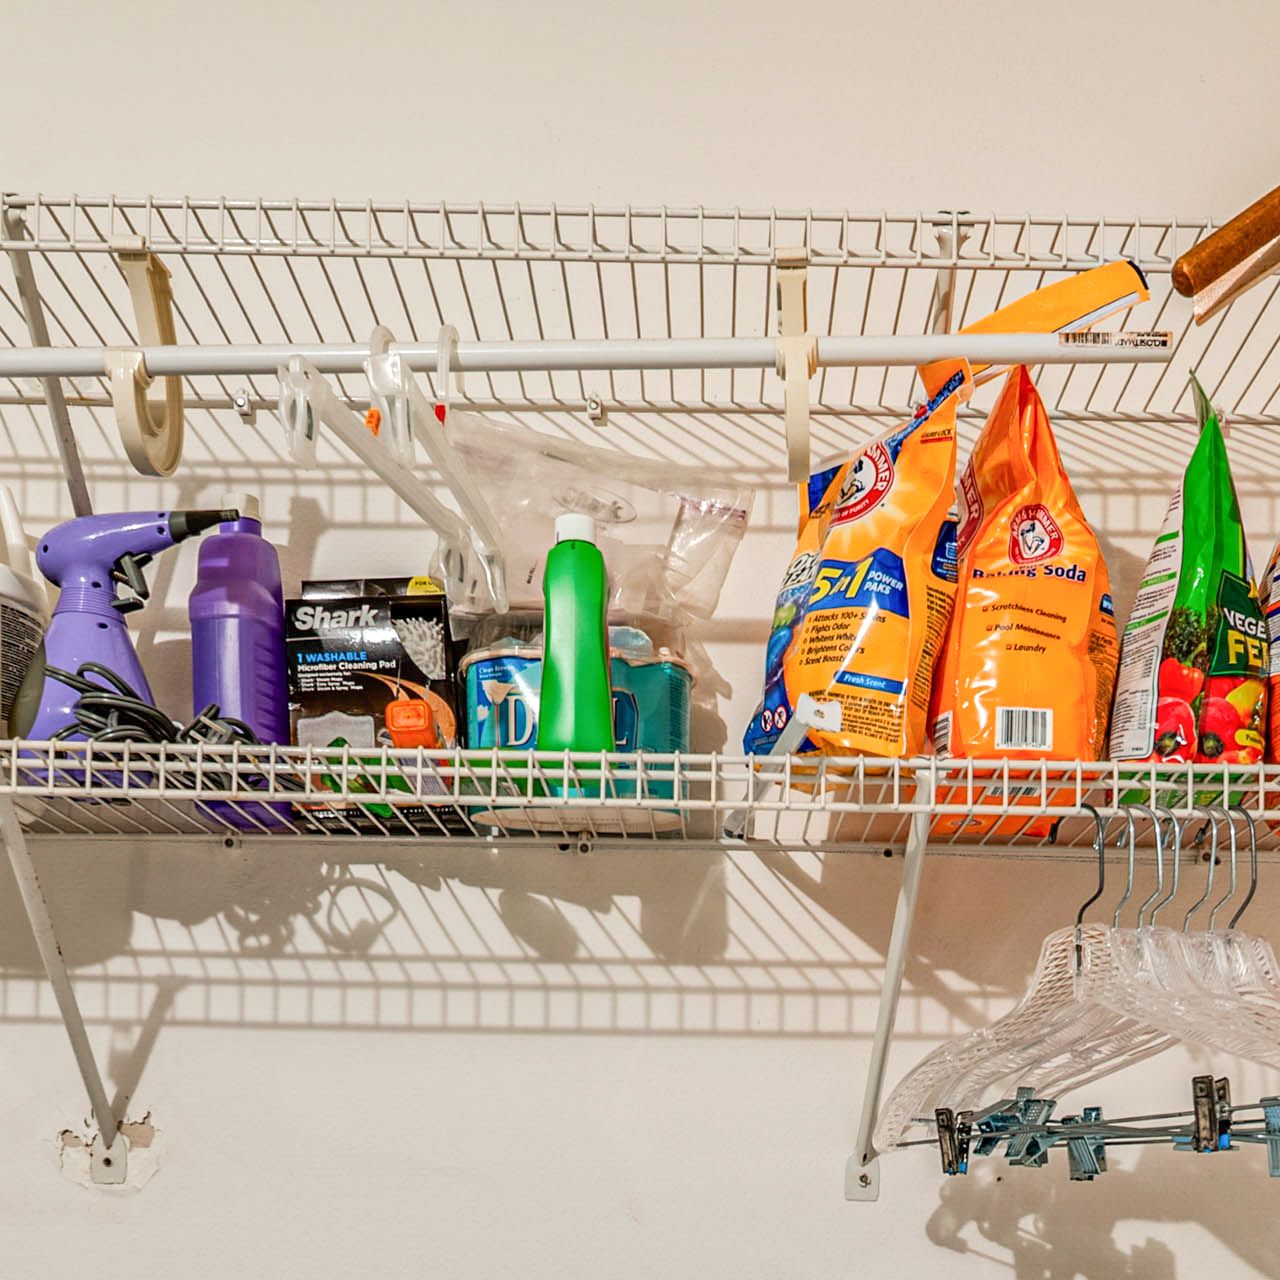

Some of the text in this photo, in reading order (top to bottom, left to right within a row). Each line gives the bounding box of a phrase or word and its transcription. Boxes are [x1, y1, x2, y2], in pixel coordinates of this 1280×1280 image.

[1044, 565, 1087, 583] Soda
[867, 570, 904, 592] POWER
[863, 581, 892, 595] PAKS
[294, 604, 378, 631] Shark
[814, 610, 858, 623] Attacks 100+
[991, 603, 1067, 623] Scratchless Cleaning
[811, 623, 850, 635] Fights Odor
[994, 623, 1062, 640] Pool Maintenance
[808, 634, 834, 644] Whitens
[806, 644, 837, 656] Brightens
[1013, 643, 1047, 655] Laundry
[297, 651, 367, 663] 1 WASHABLE
[804, 655, 823, 666] Scent
[297, 660, 397, 672] Microfiber Cleaning Pad
[844, 674, 886, 689] Fresh Scent
